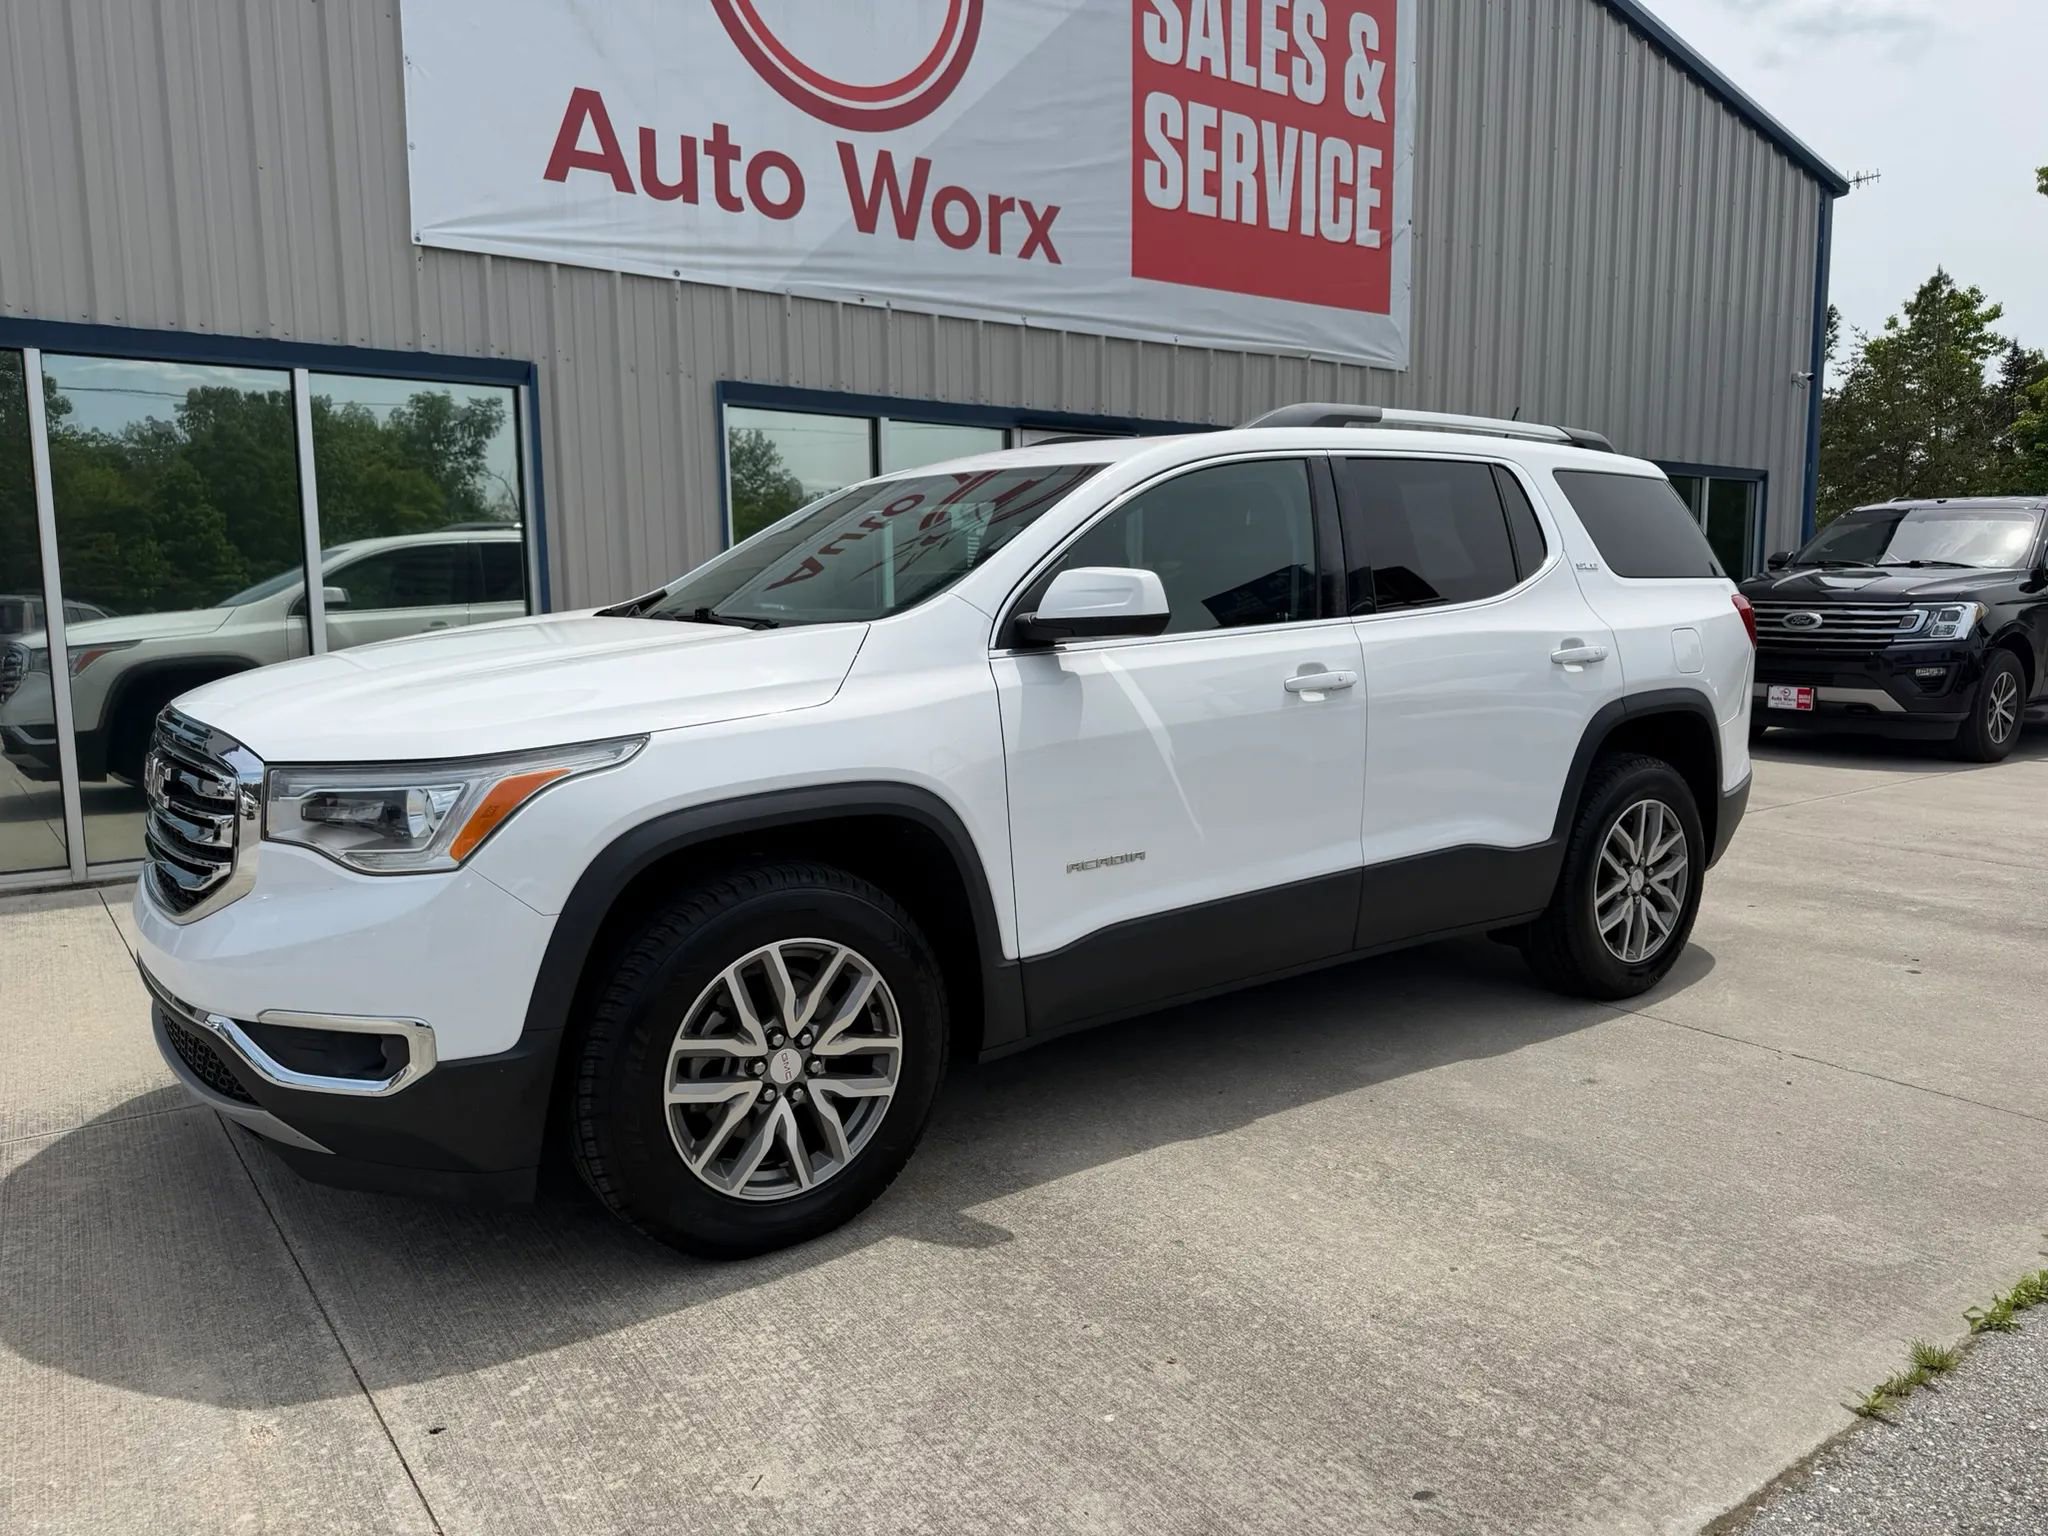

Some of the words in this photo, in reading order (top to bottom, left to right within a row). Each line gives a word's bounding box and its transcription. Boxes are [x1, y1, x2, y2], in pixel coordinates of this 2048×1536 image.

[1143, 0, 1327, 105] SALES
[1344, 12, 1386, 123] &
[543, 87, 805, 220] Auto
[836, 141, 1062, 264] Worx
[1144, 91, 1382, 249] SERVICE
[1066, 851, 1146, 874] ACADIA
[781, 1052, 792, 1081] GMC
